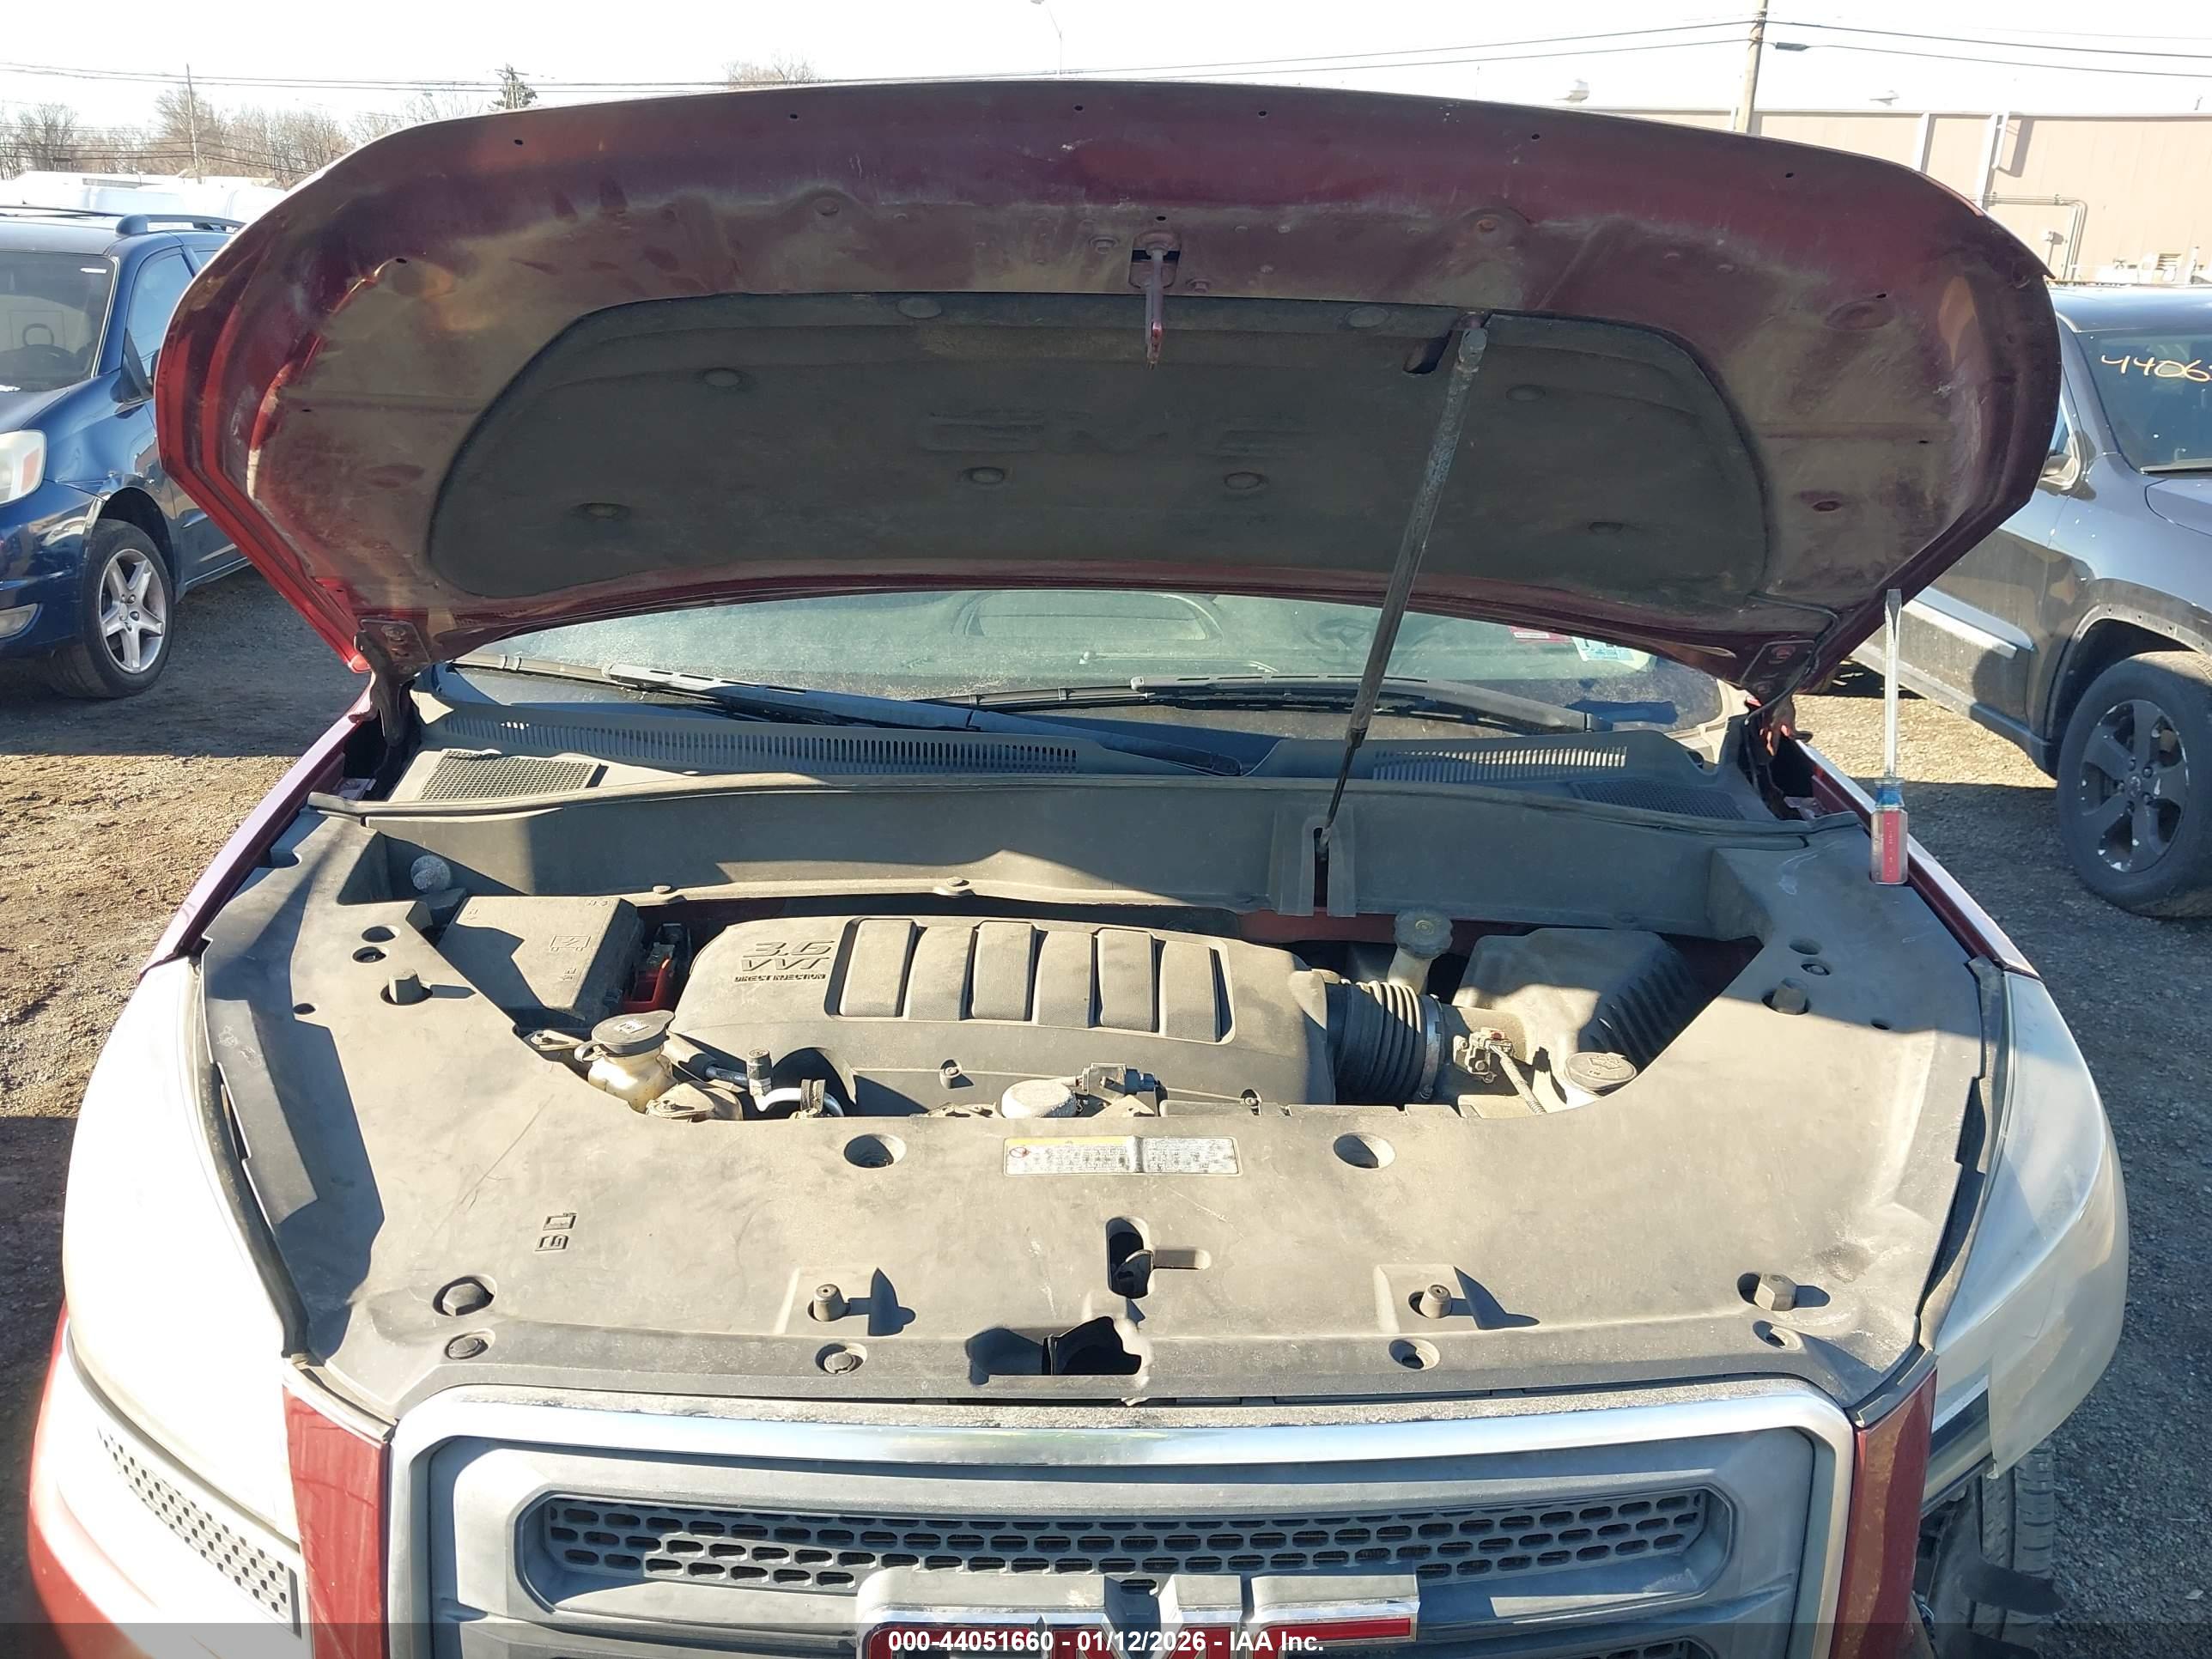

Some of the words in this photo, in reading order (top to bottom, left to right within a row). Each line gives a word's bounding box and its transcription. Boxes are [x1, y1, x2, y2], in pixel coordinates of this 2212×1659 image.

[2101, 354, 2212, 383] 4406
[742, 939, 836, 957] 3.6
[740, 957, 830, 972] VVT
